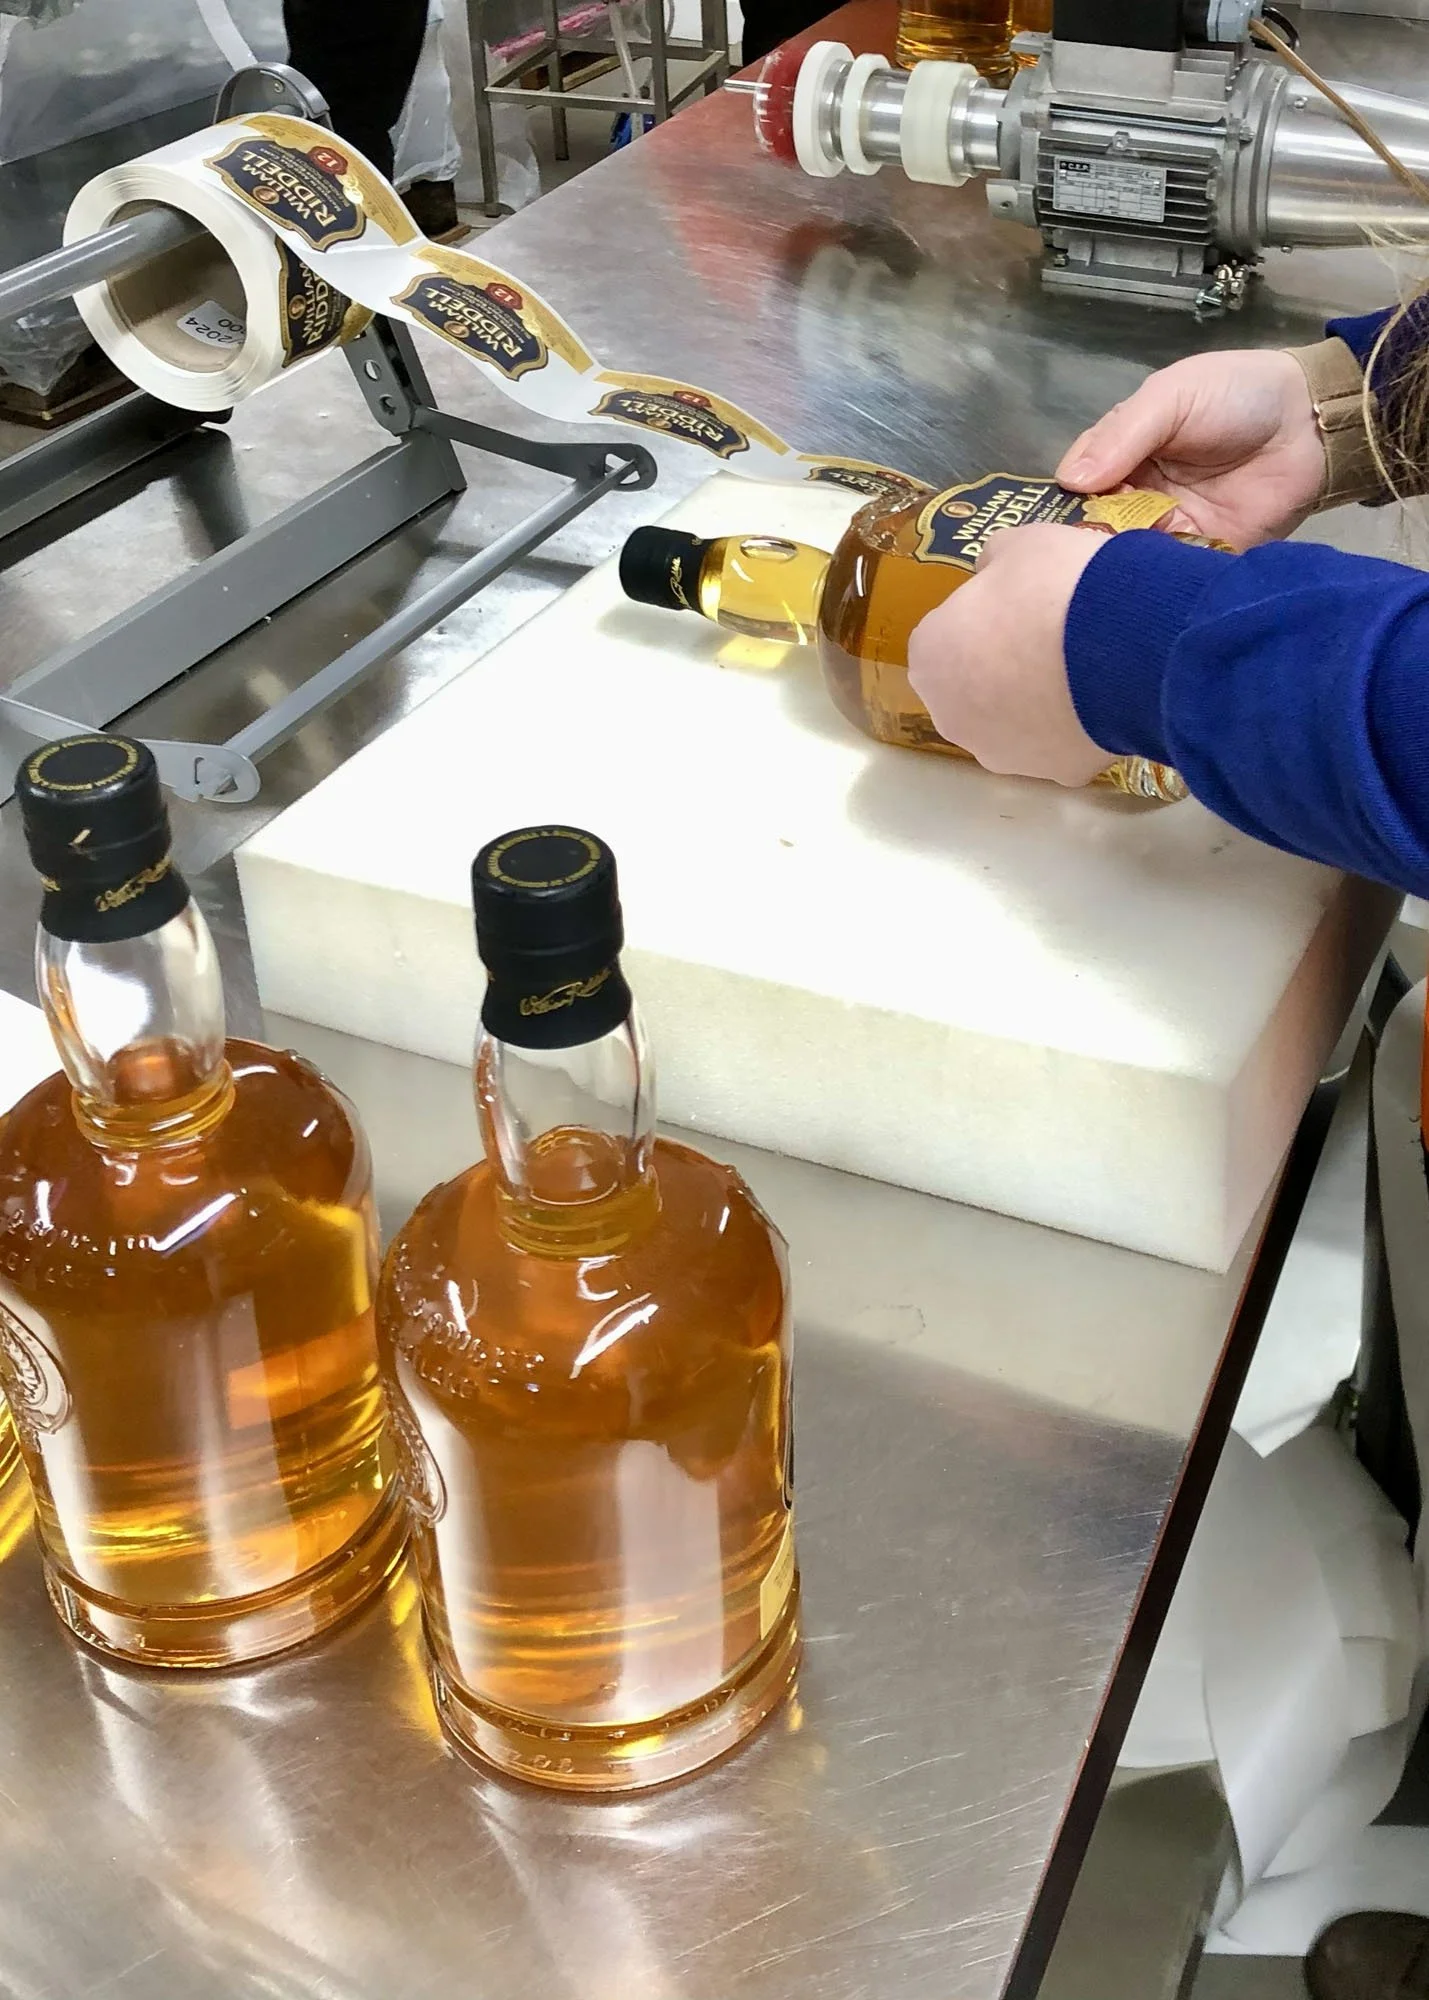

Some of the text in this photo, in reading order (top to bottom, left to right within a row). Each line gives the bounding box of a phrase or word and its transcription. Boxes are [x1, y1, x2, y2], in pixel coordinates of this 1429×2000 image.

[316, 151, 338, 167] 12
[241, 163, 309, 219] WILLIAM
[242, 150, 337, 226] RIDDELL
[307, 271, 328, 344] RIDD
[493, 287, 514, 302] 12
[425, 287, 522, 357] RIDDELL
[428, 300, 497, 350] WILLIAM
[619, 399, 724, 441] RIDDELL
[626, 407, 700, 436] WILLIAM
[951, 490, 1014, 539] WILLIAM
